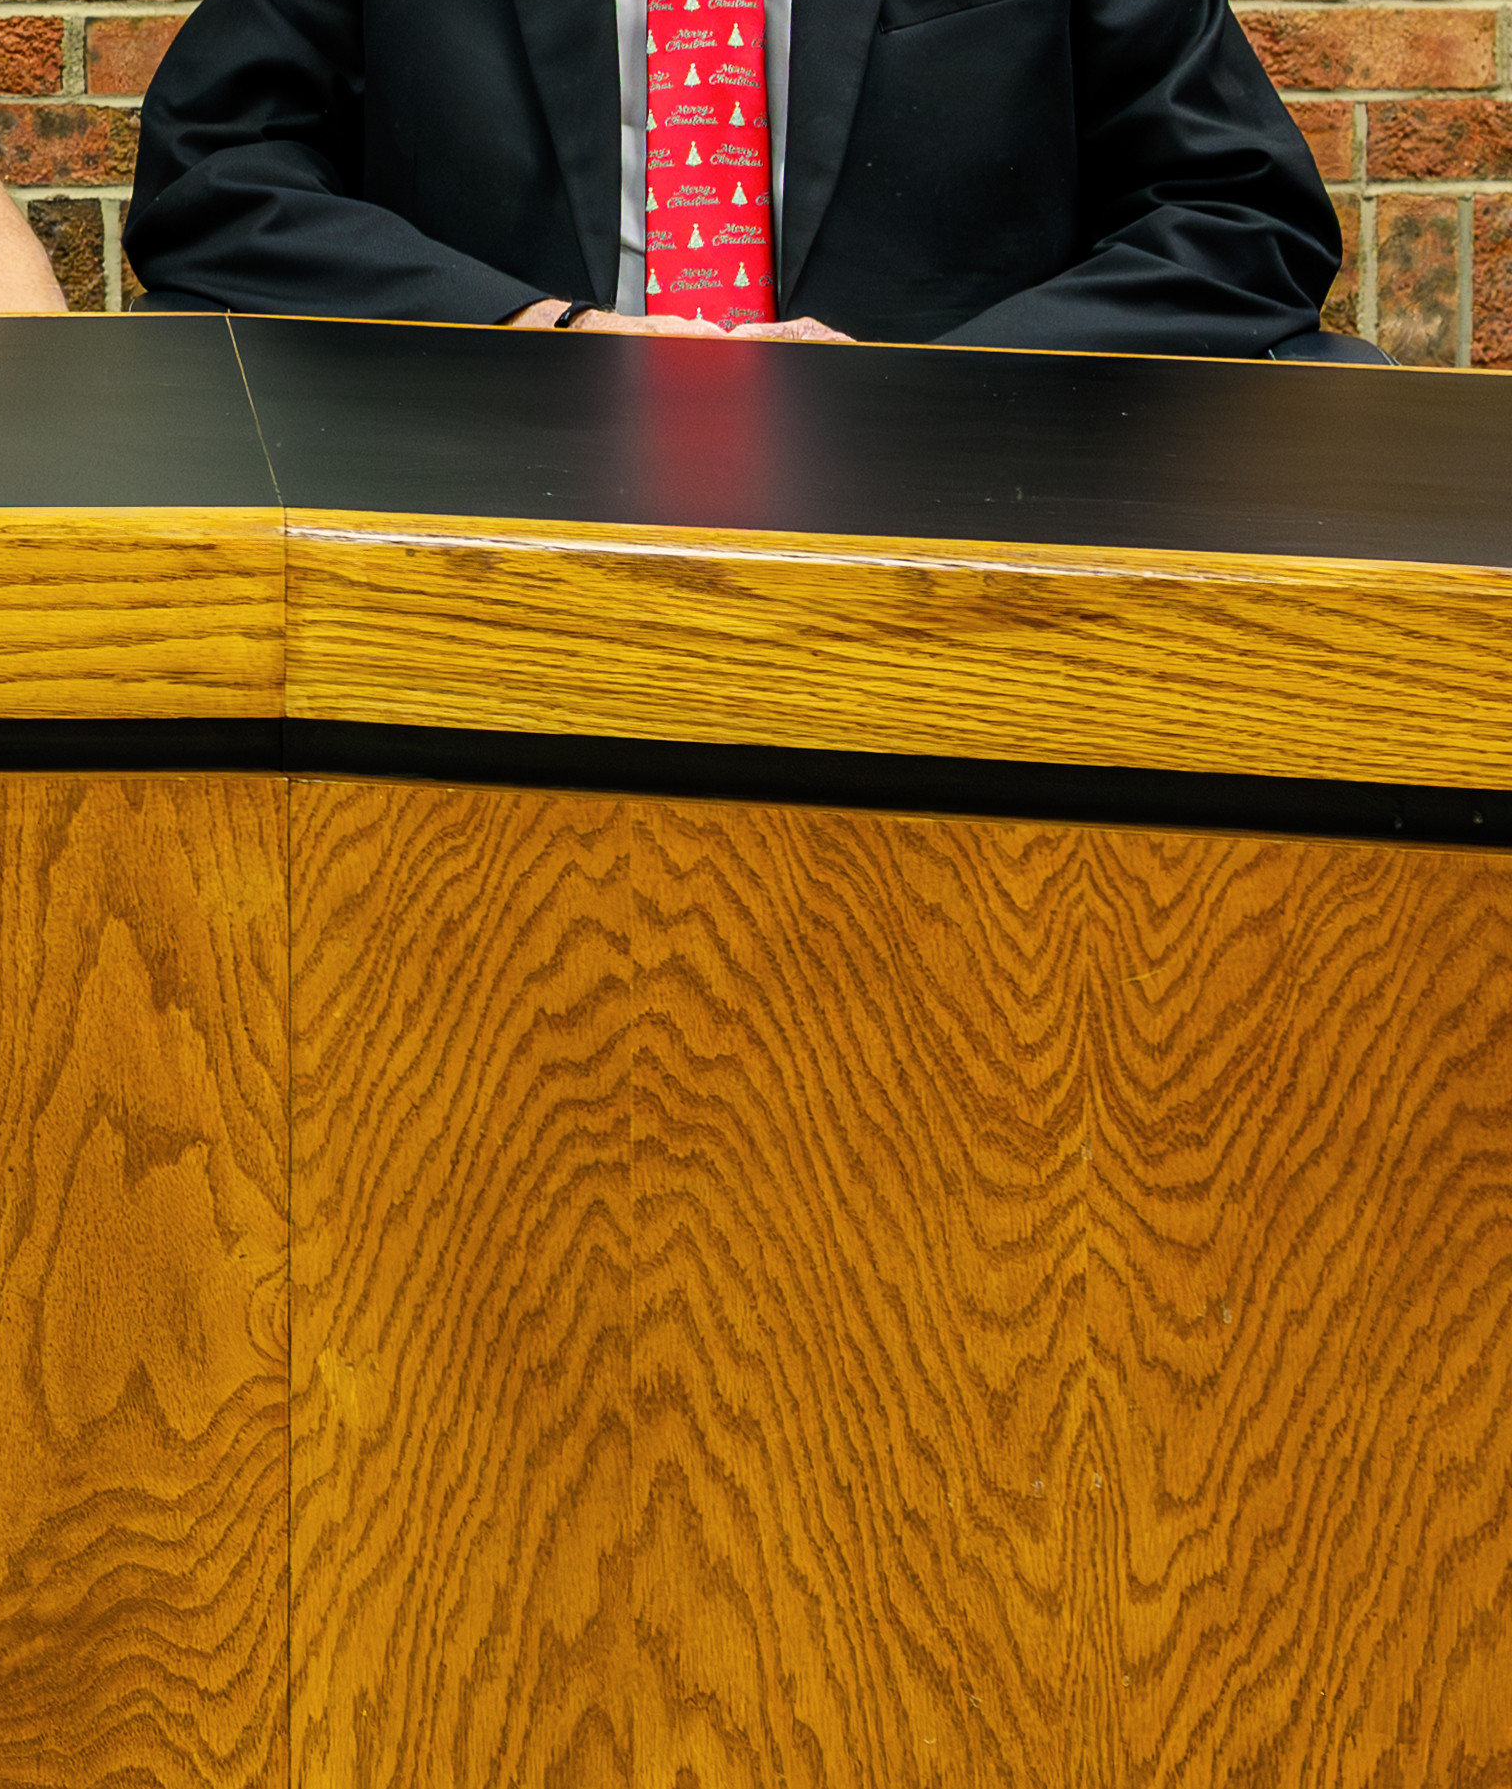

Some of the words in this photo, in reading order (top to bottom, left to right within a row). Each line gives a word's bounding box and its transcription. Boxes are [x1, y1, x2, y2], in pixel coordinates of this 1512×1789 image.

[672, 28, 714, 40] Merry
[665, 38, 718, 52] Christmas
[716, 63, 757, 77] Merry
[709, 72, 761, 88] Christmas
[671, 105, 714, 116] Merry
[664, 114, 719, 127] Christmas
[716, 143, 759, 157] Merry
[710, 153, 764, 167] Christmas
[673, 184, 717, 196] Merry
[666, 194, 721, 209] Christmas
[719, 223, 763, 236] Merry
[712, 234, 767, 247] Christmas
[676, 268, 719, 279] Merry
[670, 277, 724, 293] Christmas
